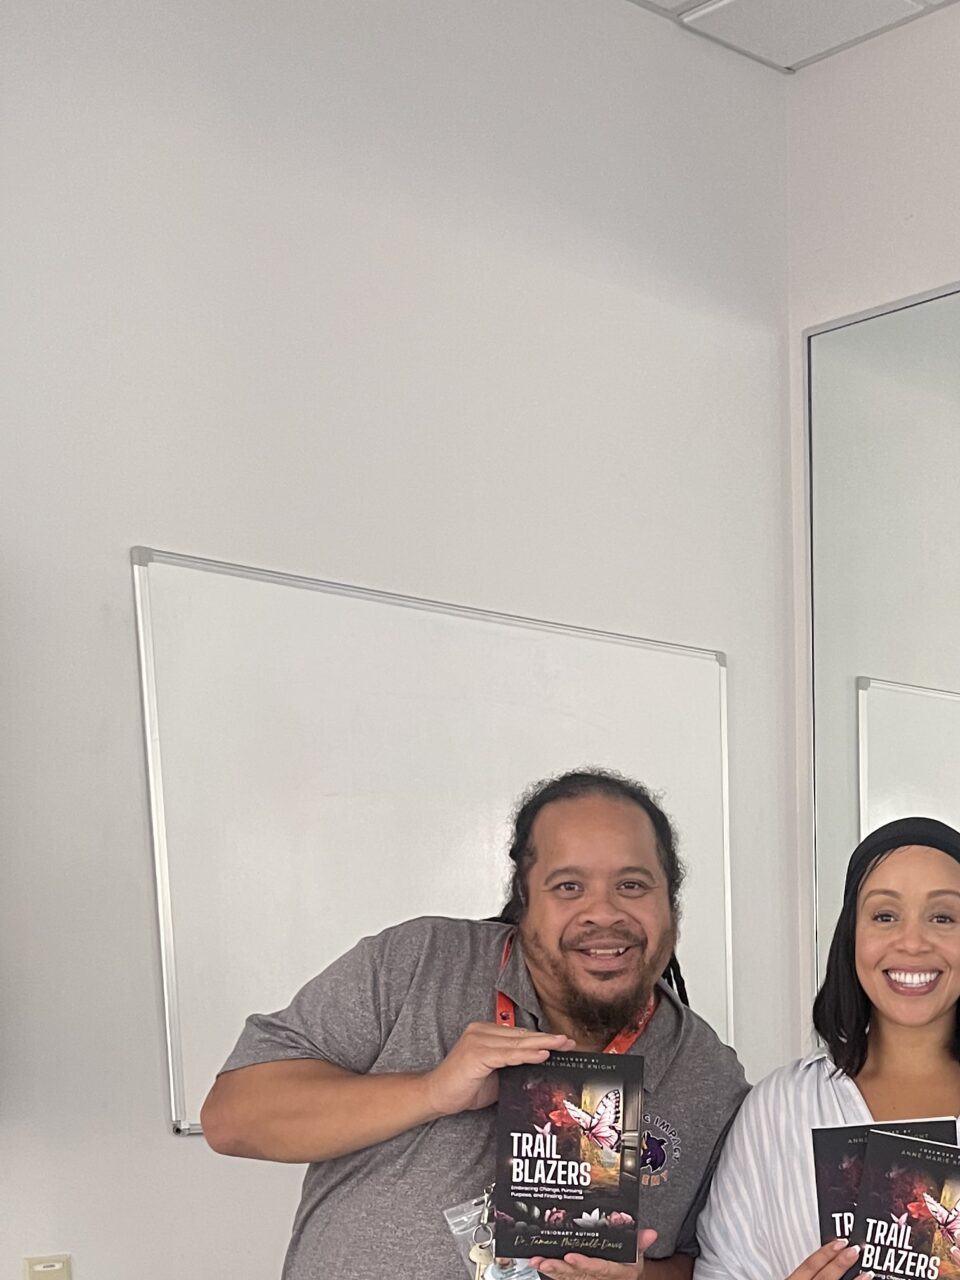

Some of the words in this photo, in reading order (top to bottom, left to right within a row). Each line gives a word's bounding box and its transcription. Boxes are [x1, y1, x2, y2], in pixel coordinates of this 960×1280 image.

[510, 1132, 561, 1159] TRAIL
[512, 1158, 592, 1187] BLAZERS
[530, 1235, 558, 1246] Tamara
[866, 1218, 913, 1250] TRAIL
[861, 1244, 940, 1280] BLAZERS
